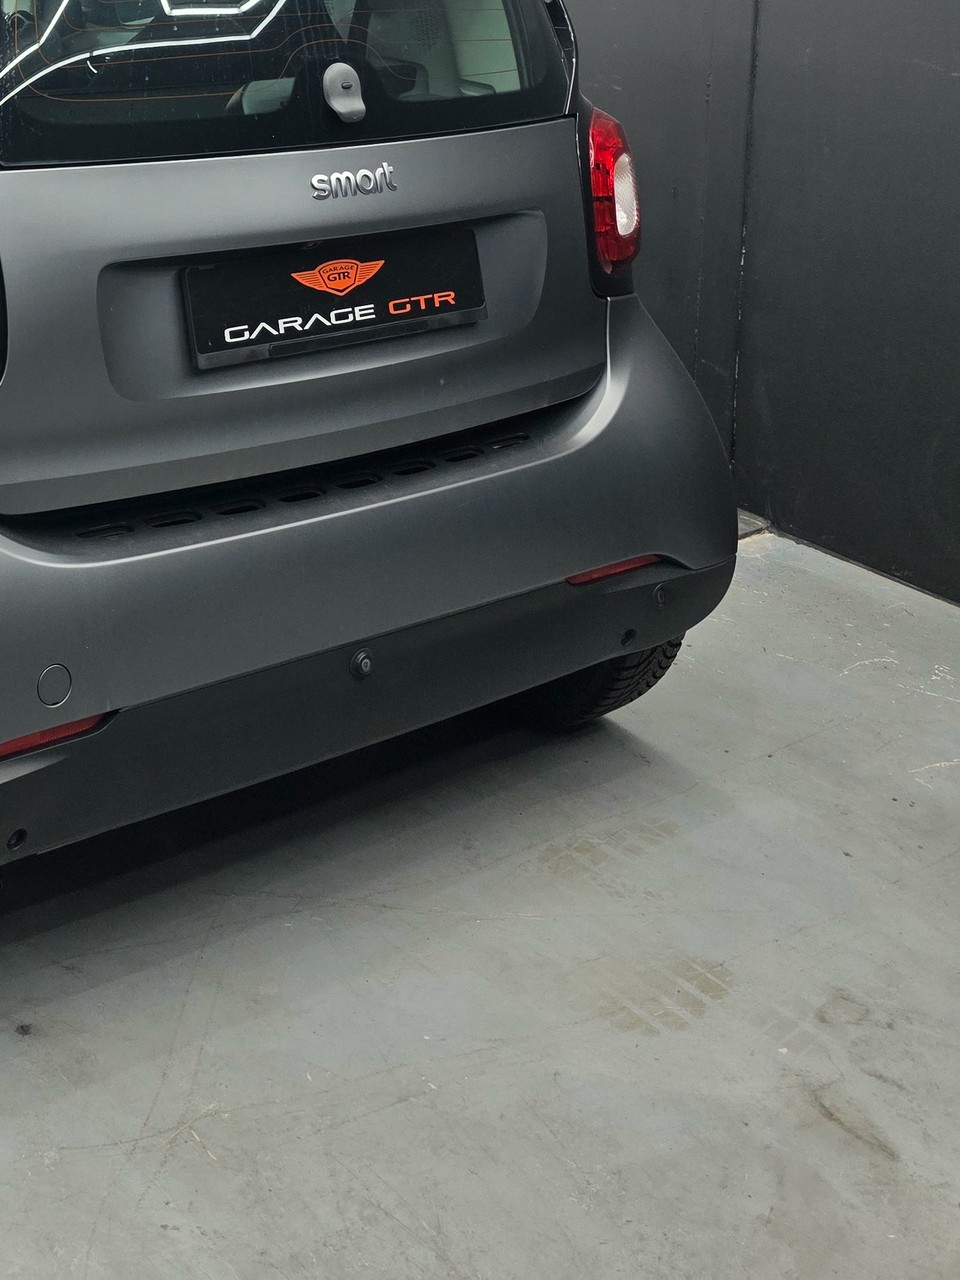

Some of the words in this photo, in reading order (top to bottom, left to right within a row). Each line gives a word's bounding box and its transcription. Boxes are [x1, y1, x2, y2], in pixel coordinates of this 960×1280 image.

[311, 162, 397, 200] smart
[322, 265, 355, 274] GARAGE
[327, 271, 351, 282] GTR
[224, 304, 376, 343] GARAGE
[388, 291, 456, 315] GTR
